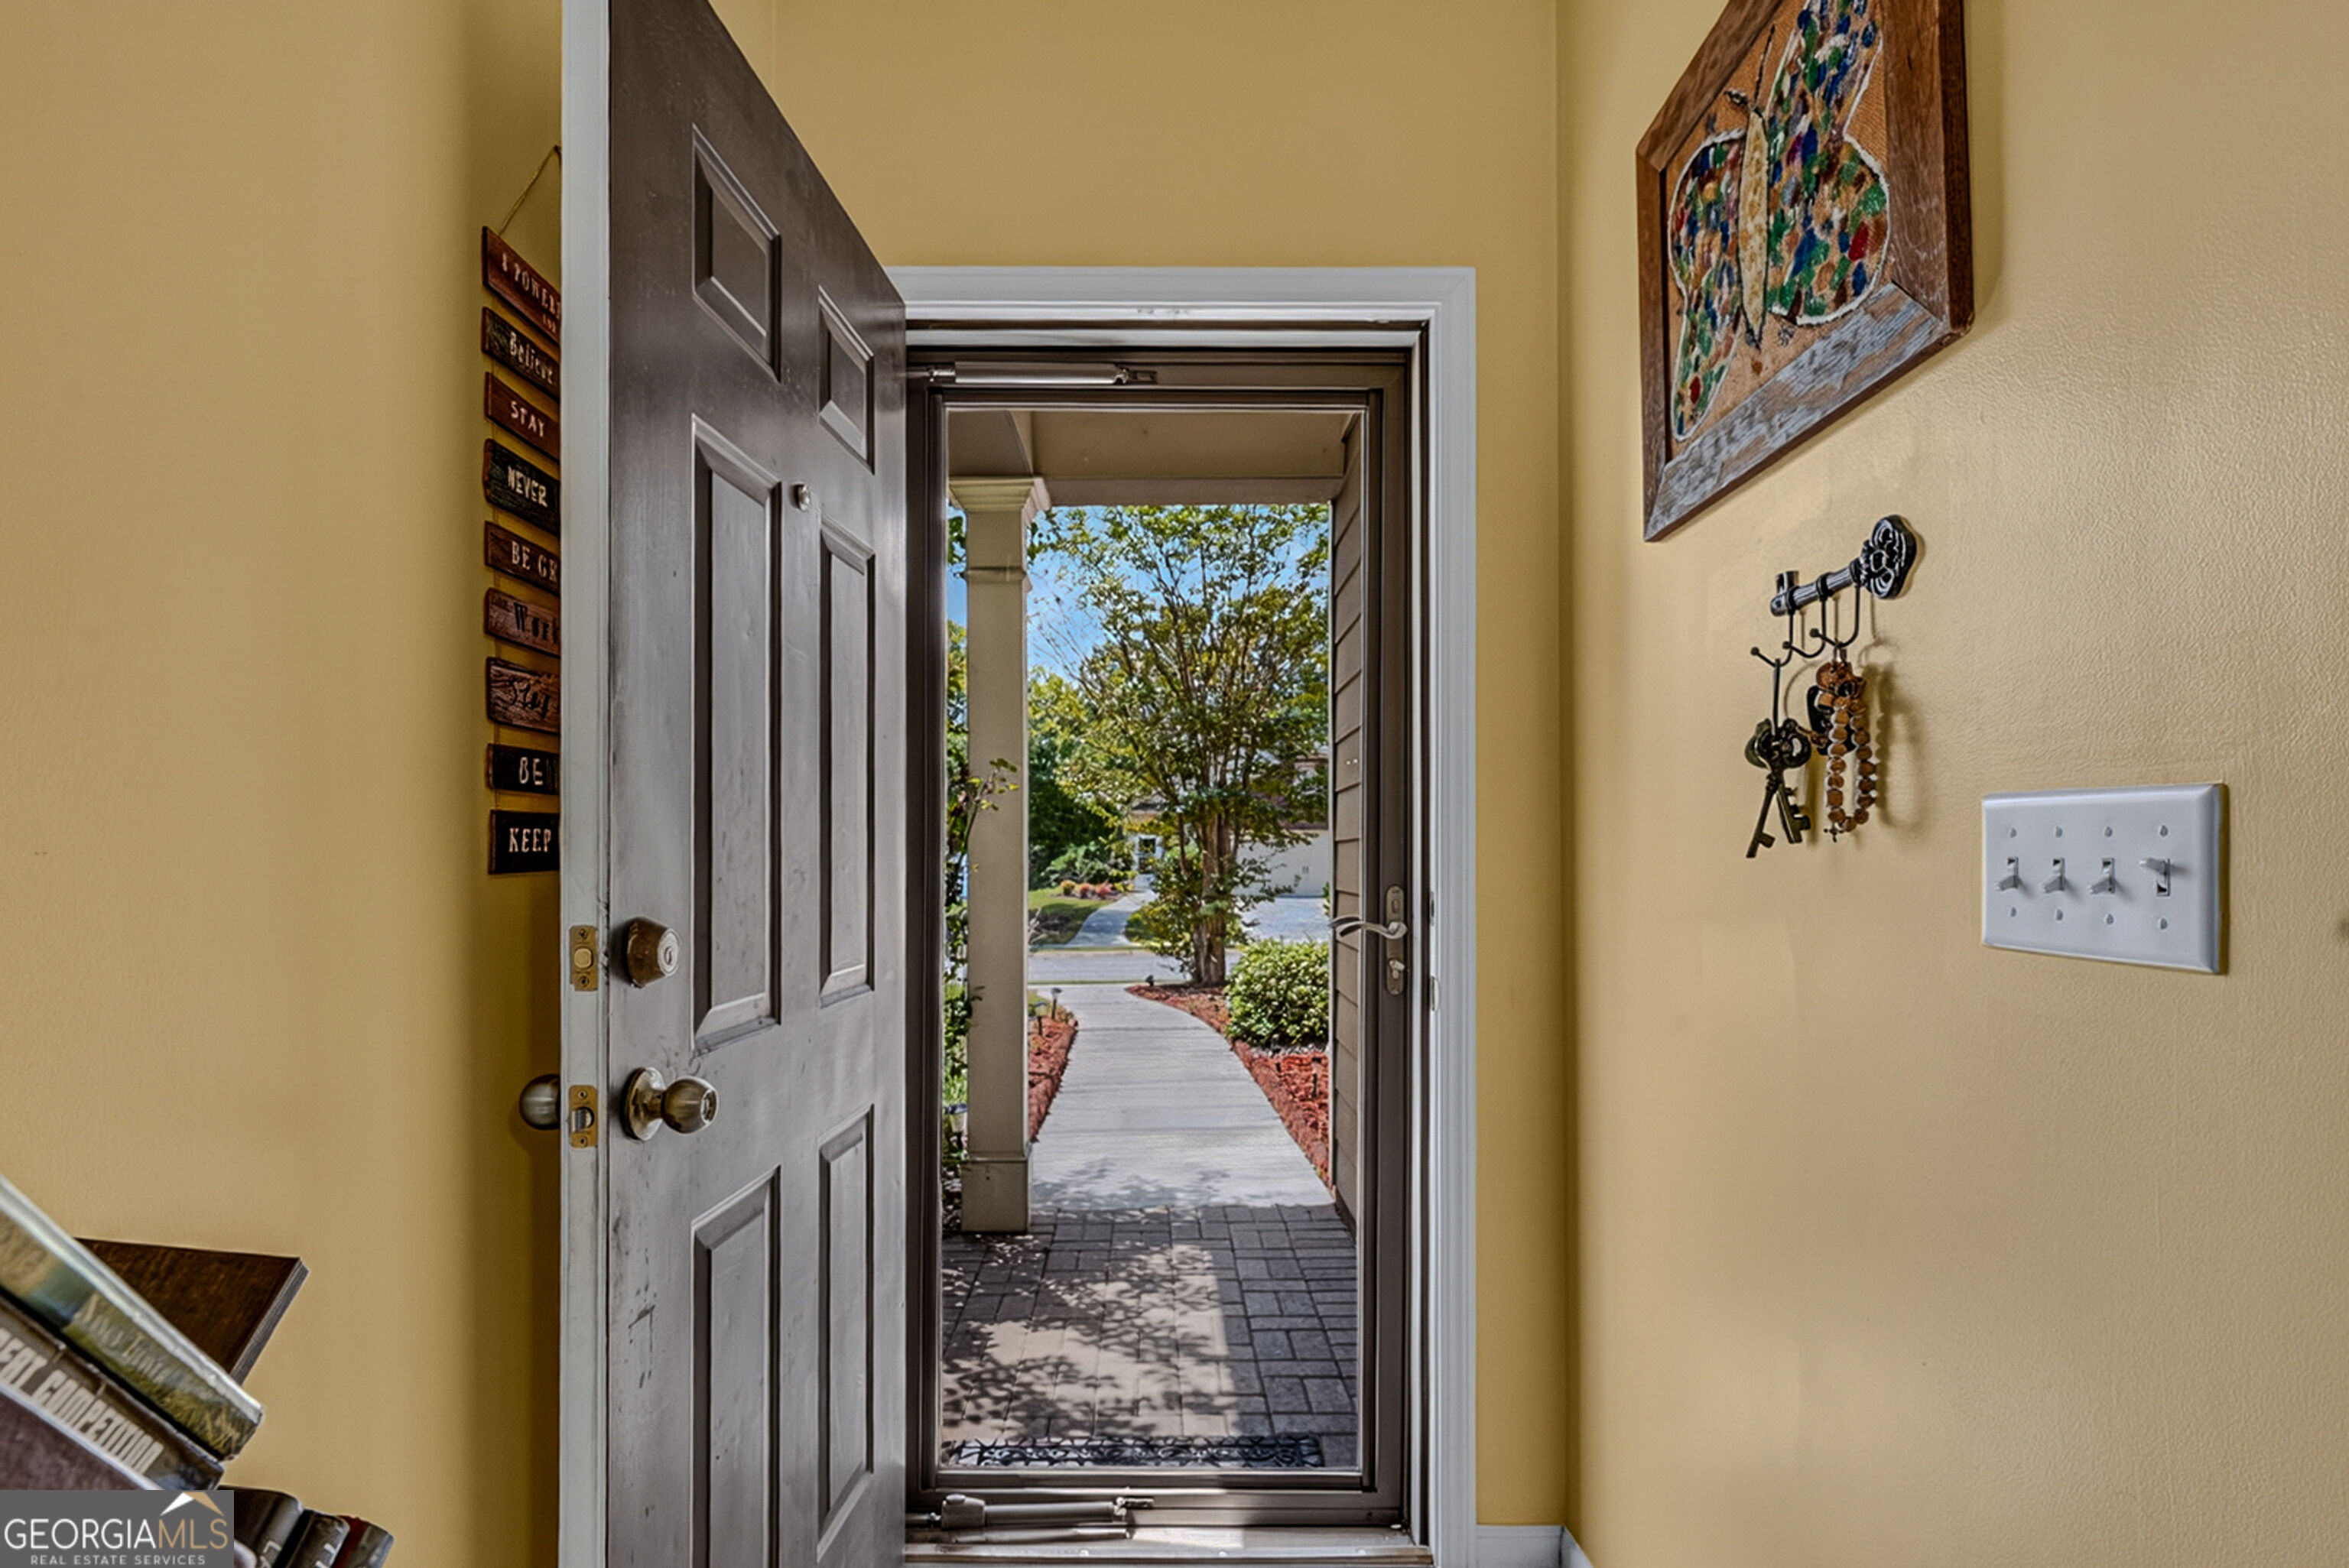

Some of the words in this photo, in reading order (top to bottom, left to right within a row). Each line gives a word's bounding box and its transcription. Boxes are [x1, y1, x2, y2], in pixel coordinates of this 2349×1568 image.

[511, 401, 544, 438] STAY
[508, 466, 547, 508] NEVER
[512, 541, 531, 570] BE
[518, 755, 544, 785] BE
[508, 826, 552, 855] KEEP
[32, 1369, 164, 1475] COMPETITION
